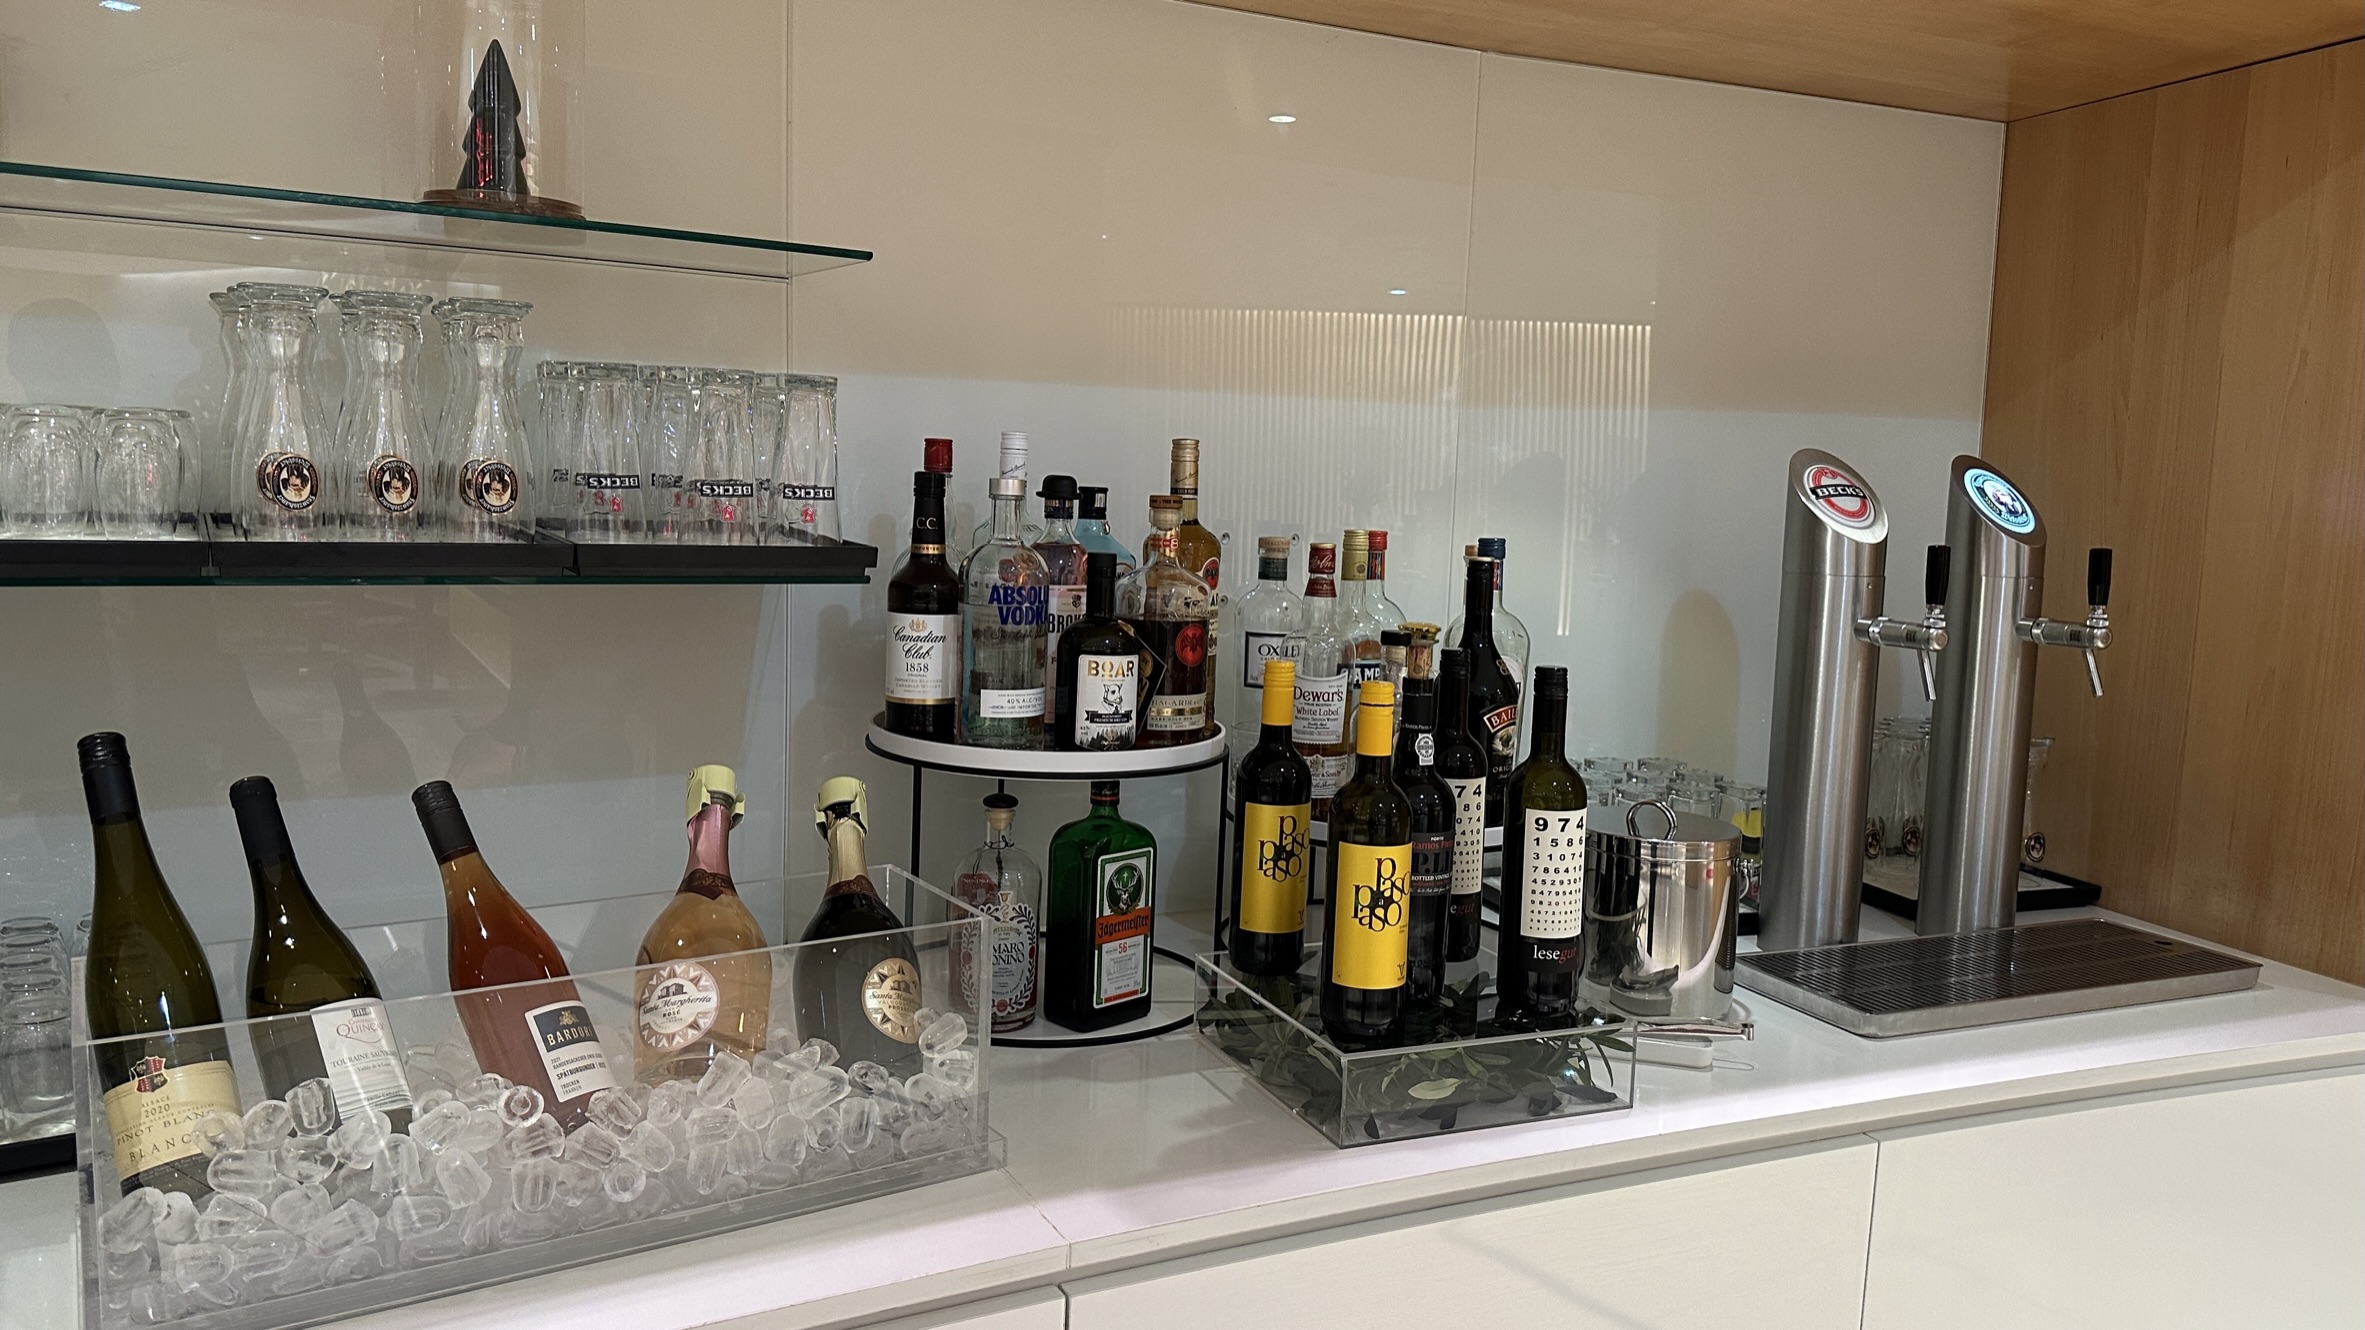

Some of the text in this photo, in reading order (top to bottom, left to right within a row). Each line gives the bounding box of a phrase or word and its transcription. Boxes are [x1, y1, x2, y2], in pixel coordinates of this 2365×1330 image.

[589, 476, 638, 488] BECK'S
[702, 485, 752, 497] BECK'S
[785, 487, 834, 499] BECK'S
[1817, 485, 1864, 498] BECK'S
[892, 624, 947, 643] Canadian
[905, 662, 929, 673] 1858
[1087, 660, 1135, 678] BOAR
[1293, 685, 1344, 702] Dewar's
[1454, 783, 1482, 798] 7 4
[1463, 802, 1481, 812] 8 6
[1534, 815, 1584, 833] 9 7 4
[1533, 836, 1583, 847] 1 5 8 6
[1533, 852, 1540, 860] 3
[1547, 853, 1553, 861] 1
[1559, 853, 1566, 861] 0
[1570, 852, 1576, 861] 7
[1532, 865, 1539, 873] 7
[1543, 866, 1550, 874] 8
[1351, 884, 1402, 933] paso
[1378, 898, 1384, 906] a
[1450, 902, 1475, 917] egut
[1097, 914, 1149, 939] Jägermeister
[992, 941, 1025, 955] MARO
[1118, 941, 1128, 954] 56
[992, 952, 1025, 966] ONINO
[660, 994, 712, 1009] Margherita
[868, 990, 893, 1000] Santa
[330, 1052, 370, 1069] TOURAINE
[141, 1095, 171, 1109] ALSACE
[144, 1103, 171, 1118] 2020
[116, 1126, 154, 1146] PINOT
